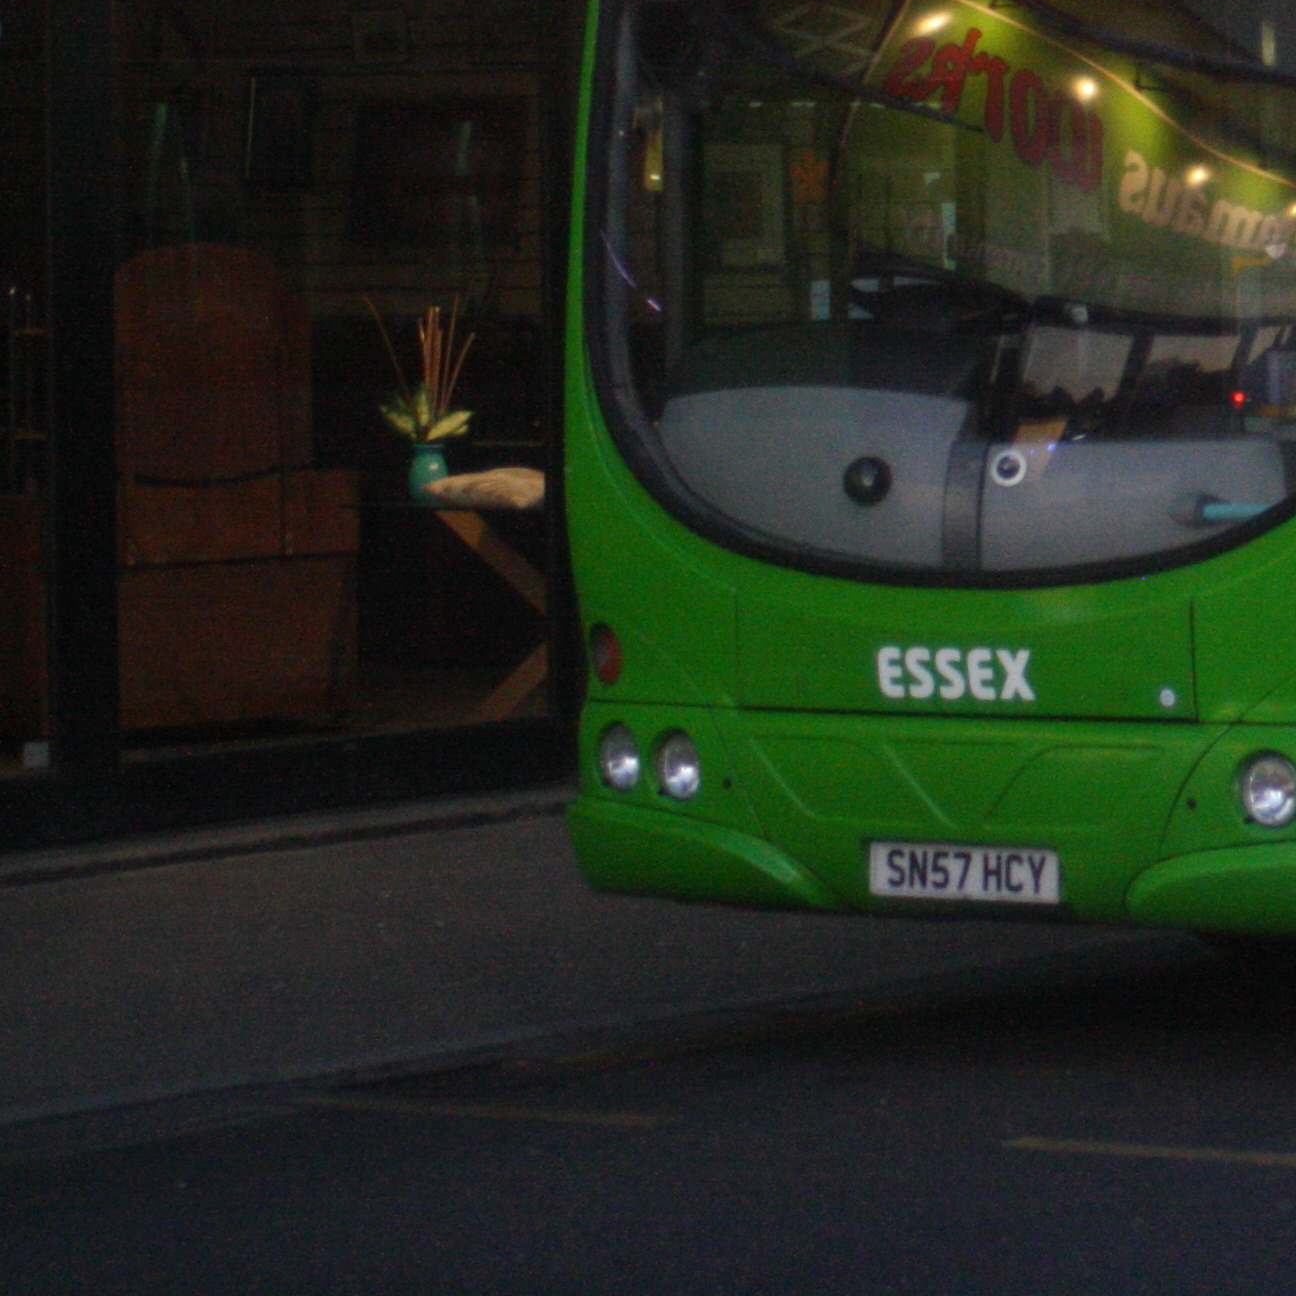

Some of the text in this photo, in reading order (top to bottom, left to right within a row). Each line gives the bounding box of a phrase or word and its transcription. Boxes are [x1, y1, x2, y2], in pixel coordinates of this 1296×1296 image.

[877, 646, 1036, 702] ESSEX
[886, 849, 1047, 895] SN57 HCY
